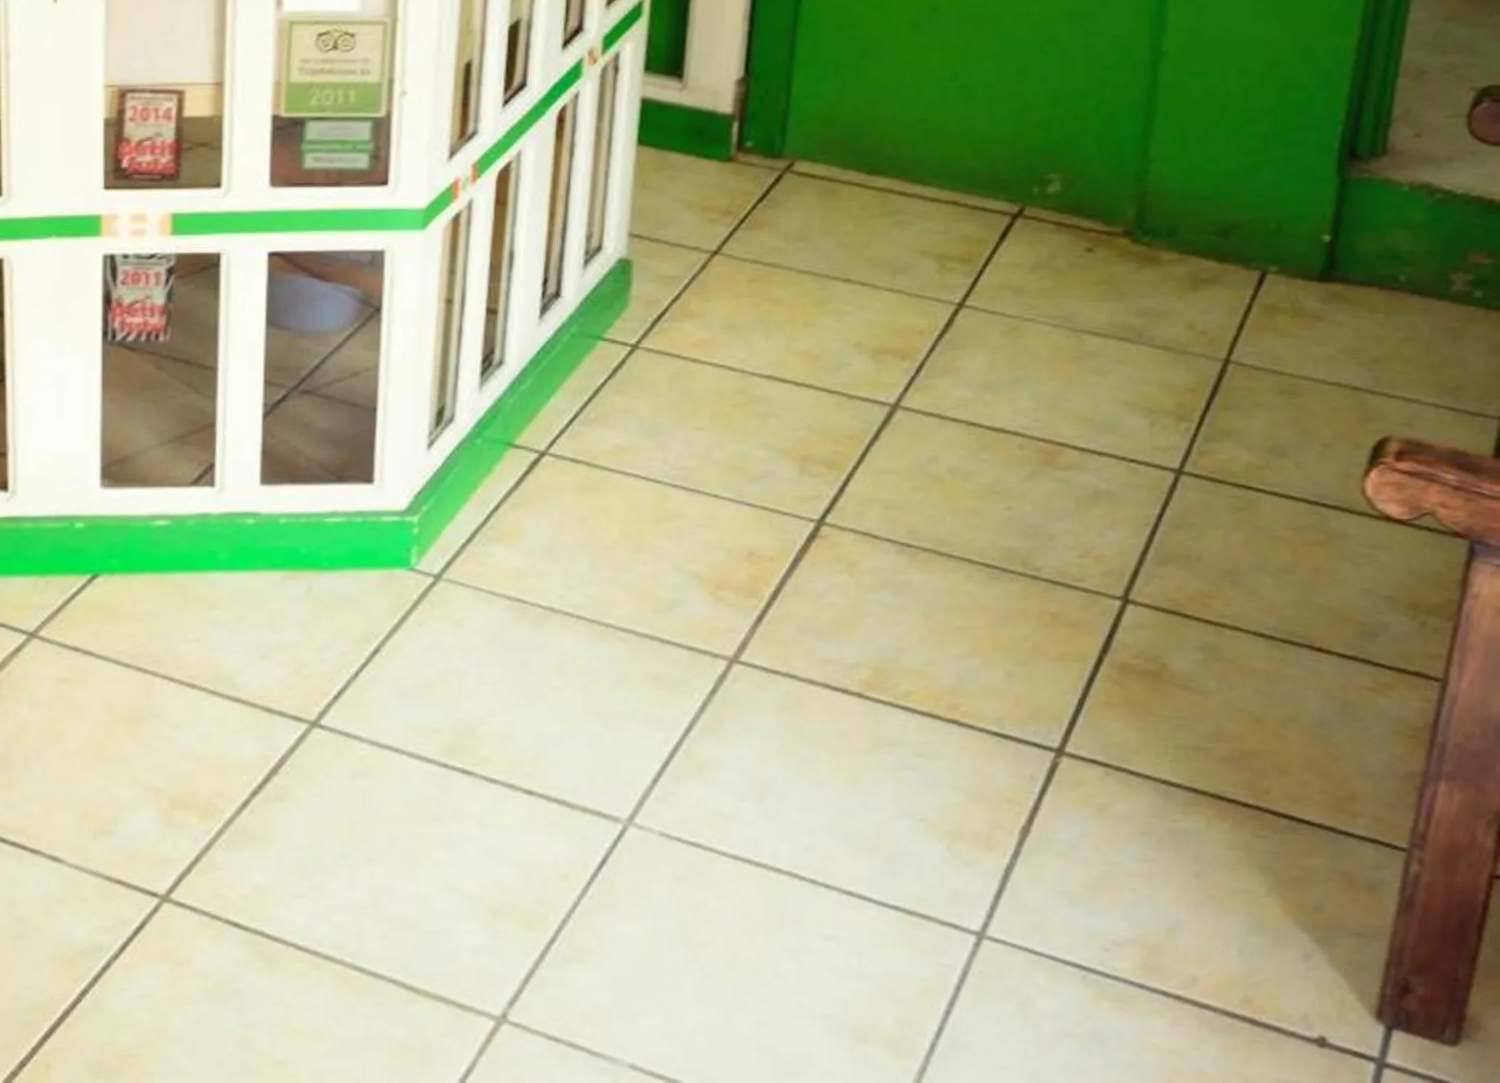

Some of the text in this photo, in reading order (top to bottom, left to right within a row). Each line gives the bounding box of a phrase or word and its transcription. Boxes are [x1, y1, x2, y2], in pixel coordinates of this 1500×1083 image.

[308, 86, 357, 107] 2011
[128, 104, 175, 123] 2014
[120, 268, 163, 287] 2011
